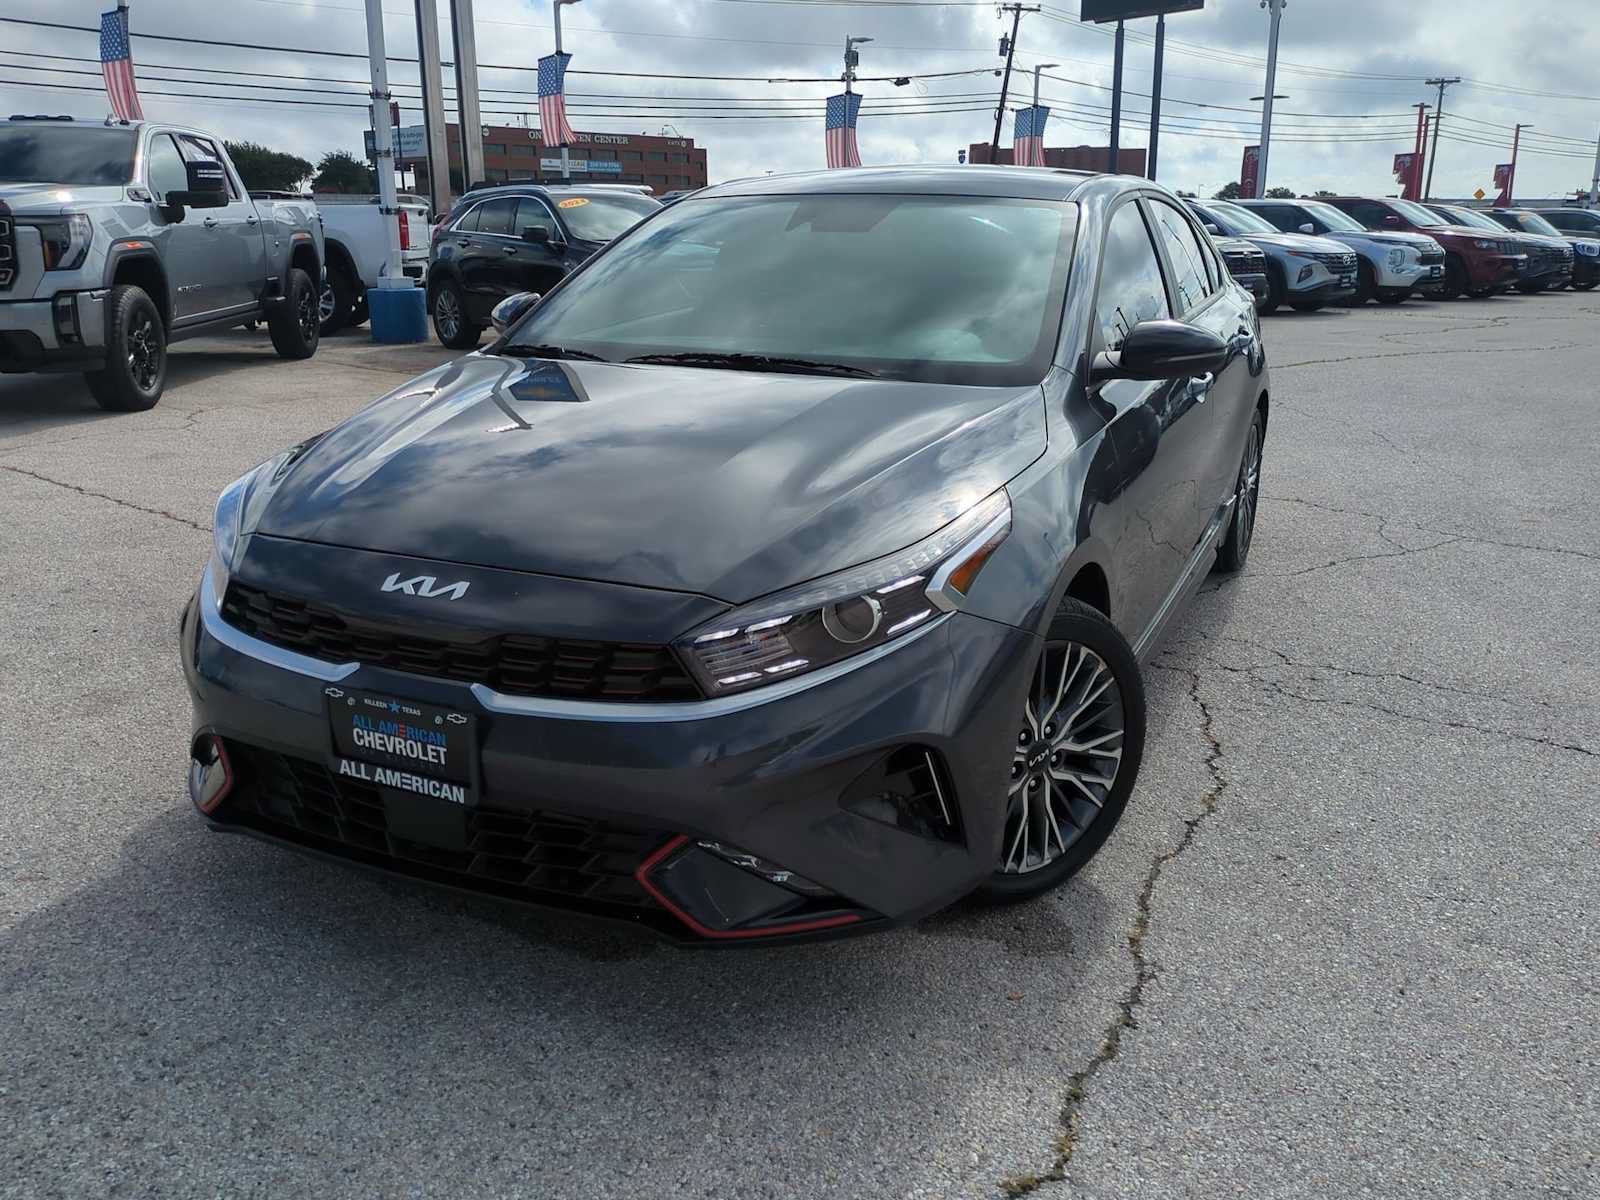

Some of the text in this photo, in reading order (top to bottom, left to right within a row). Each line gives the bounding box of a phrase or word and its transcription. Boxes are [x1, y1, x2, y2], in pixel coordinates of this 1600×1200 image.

[594, 134, 629, 145] CENTER
[380, 572, 471, 601] KIA
[363, 697, 421, 716] KILLEEN TEXAS
[352, 713, 447, 746] ALL AMERICAN
[352, 727, 448, 765] CHEVROLET
[339, 759, 465, 804] ALL AMERICAN
